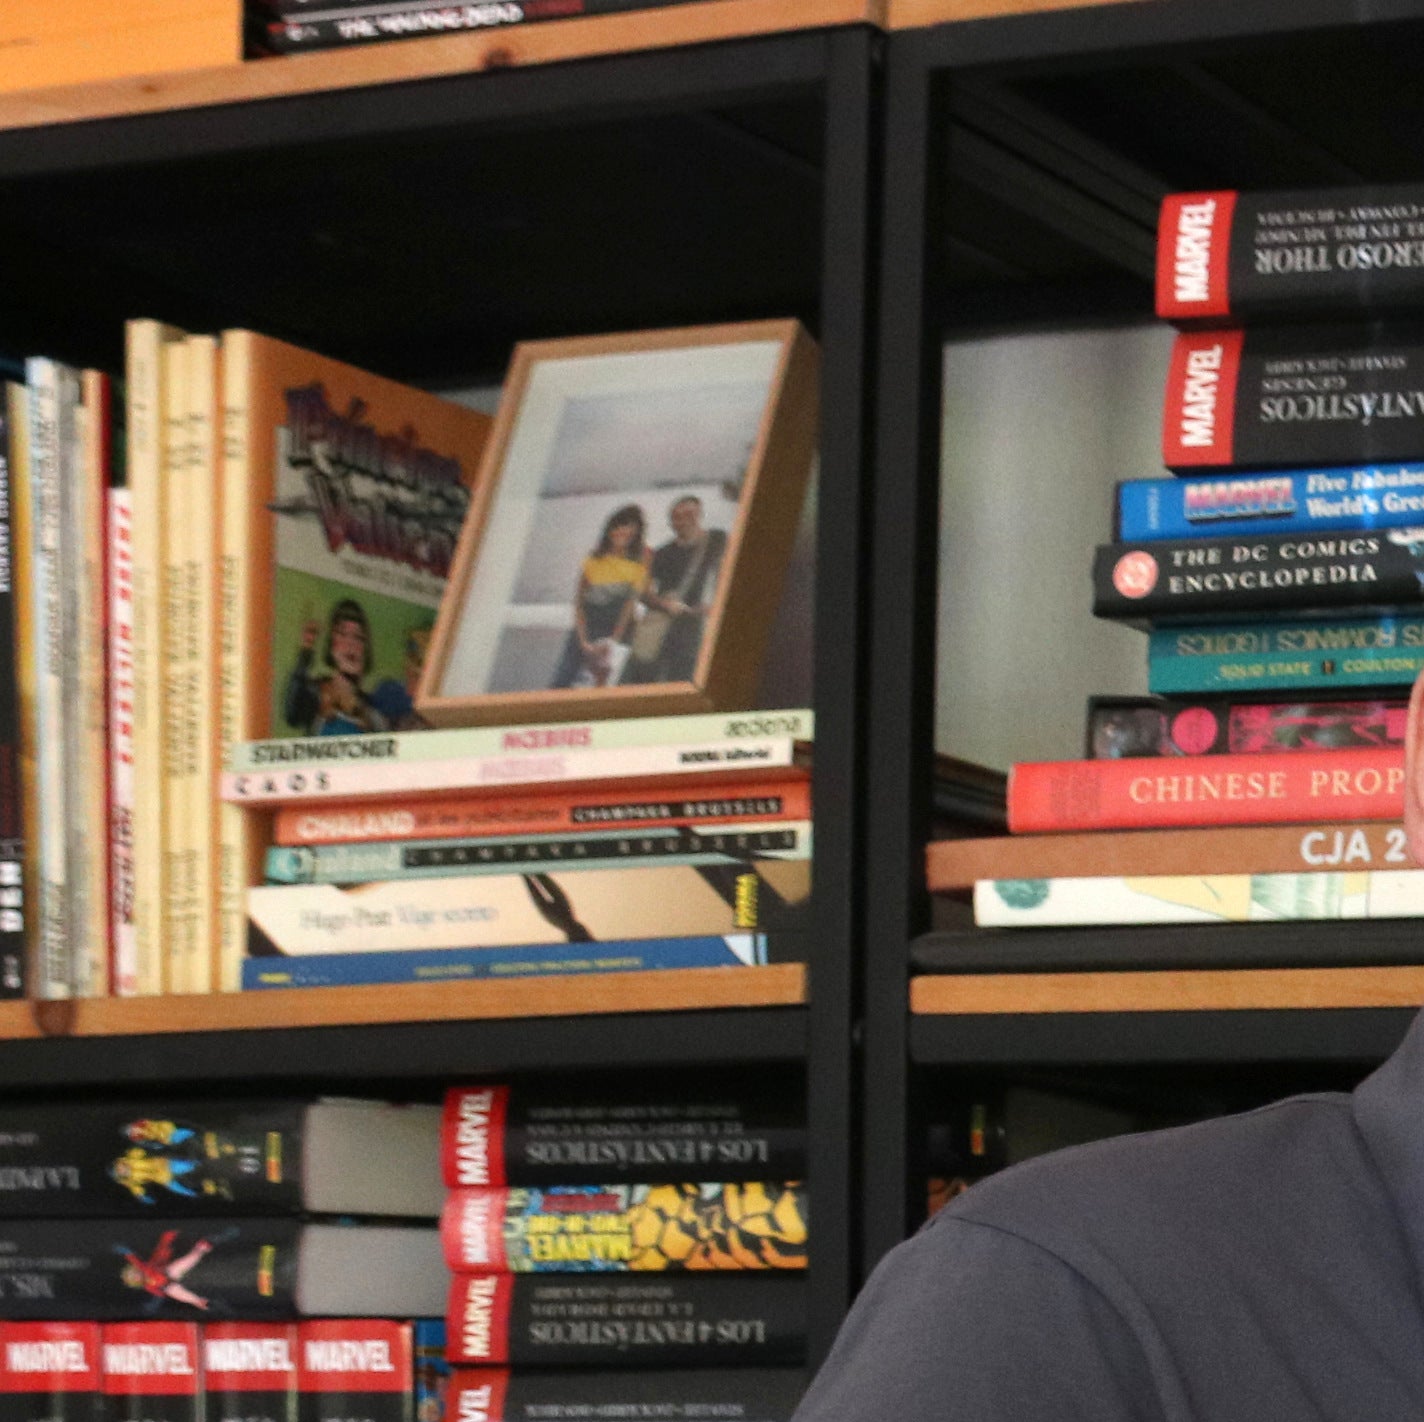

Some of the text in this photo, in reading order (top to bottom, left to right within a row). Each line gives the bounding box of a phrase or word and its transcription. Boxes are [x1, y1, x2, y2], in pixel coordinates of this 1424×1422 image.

[1174, 198, 1216, 302] MARVEL
[1254, 244, 1332, 274] THOR
[1180, 346, 1222, 447] MARVEL
[1307, 472, 1348, 493] Five
[1306, 495, 1380, 518] World's
[1170, 539, 1380, 567] THE DC COMICS
[1168, 564, 1378, 594] ENCYCLOPEDIA
[251, 739, 399, 764] STARWATCHER
[1129, 767, 1405, 804] CHINESE PROP
[1300, 830, 1372, 864] CJA
[456, 1091, 494, 1185] MARVEL
[718, 1138, 768, 1162] LOS
[459, 1196, 490, 1264] MARVEL
[528, 1234, 631, 1260] MARVEL
[463, 1276, 497, 1358] MARVEL
[717, 1318, 765, 1342] LOS
[5, 1340, 89, 1374] MARVEL
[104, 1343, 195, 1377] MARVEL
[205, 1338, 295, 1373] MARVEL
[305, 1338, 394, 1374] MARVEL
